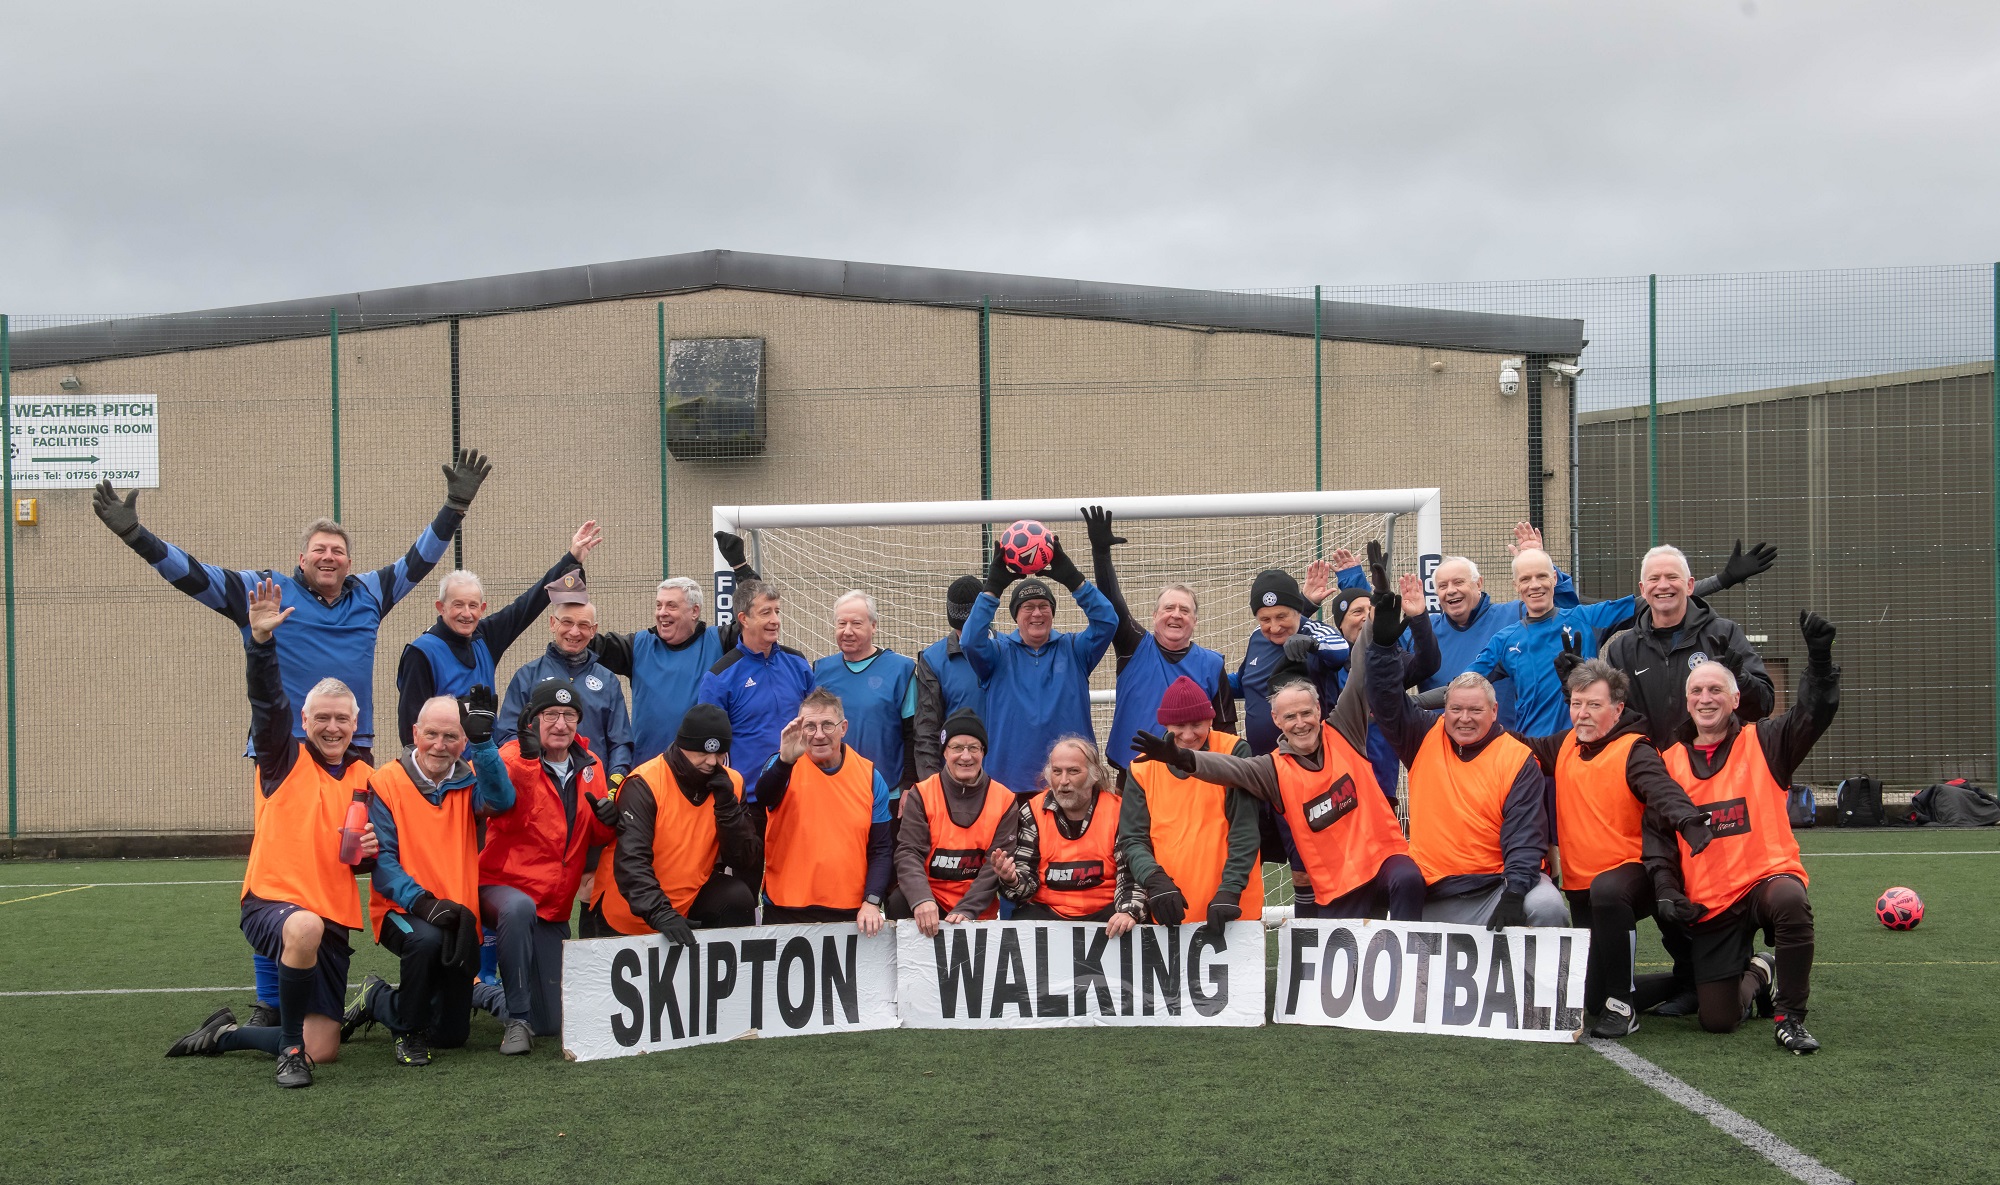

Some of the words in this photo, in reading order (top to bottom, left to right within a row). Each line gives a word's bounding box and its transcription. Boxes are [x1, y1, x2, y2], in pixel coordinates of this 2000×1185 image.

[14, 404, 97, 418] WEATHER
[103, 403, 153, 417] PITCH
[40, 424, 109, 434] CHANGING
[114, 424, 152, 434] ROOM
[32, 437, 99, 447] FACILITIES
[43, 471, 61, 480] Tel:
[66, 471, 97, 480] 01756
[102, 470, 140, 480] 793747
[610, 934, 860, 1048] SKIPTON
[933, 924, 1229, 1019] WALKING
[1285, 926, 1584, 1031] FOOTBALL
